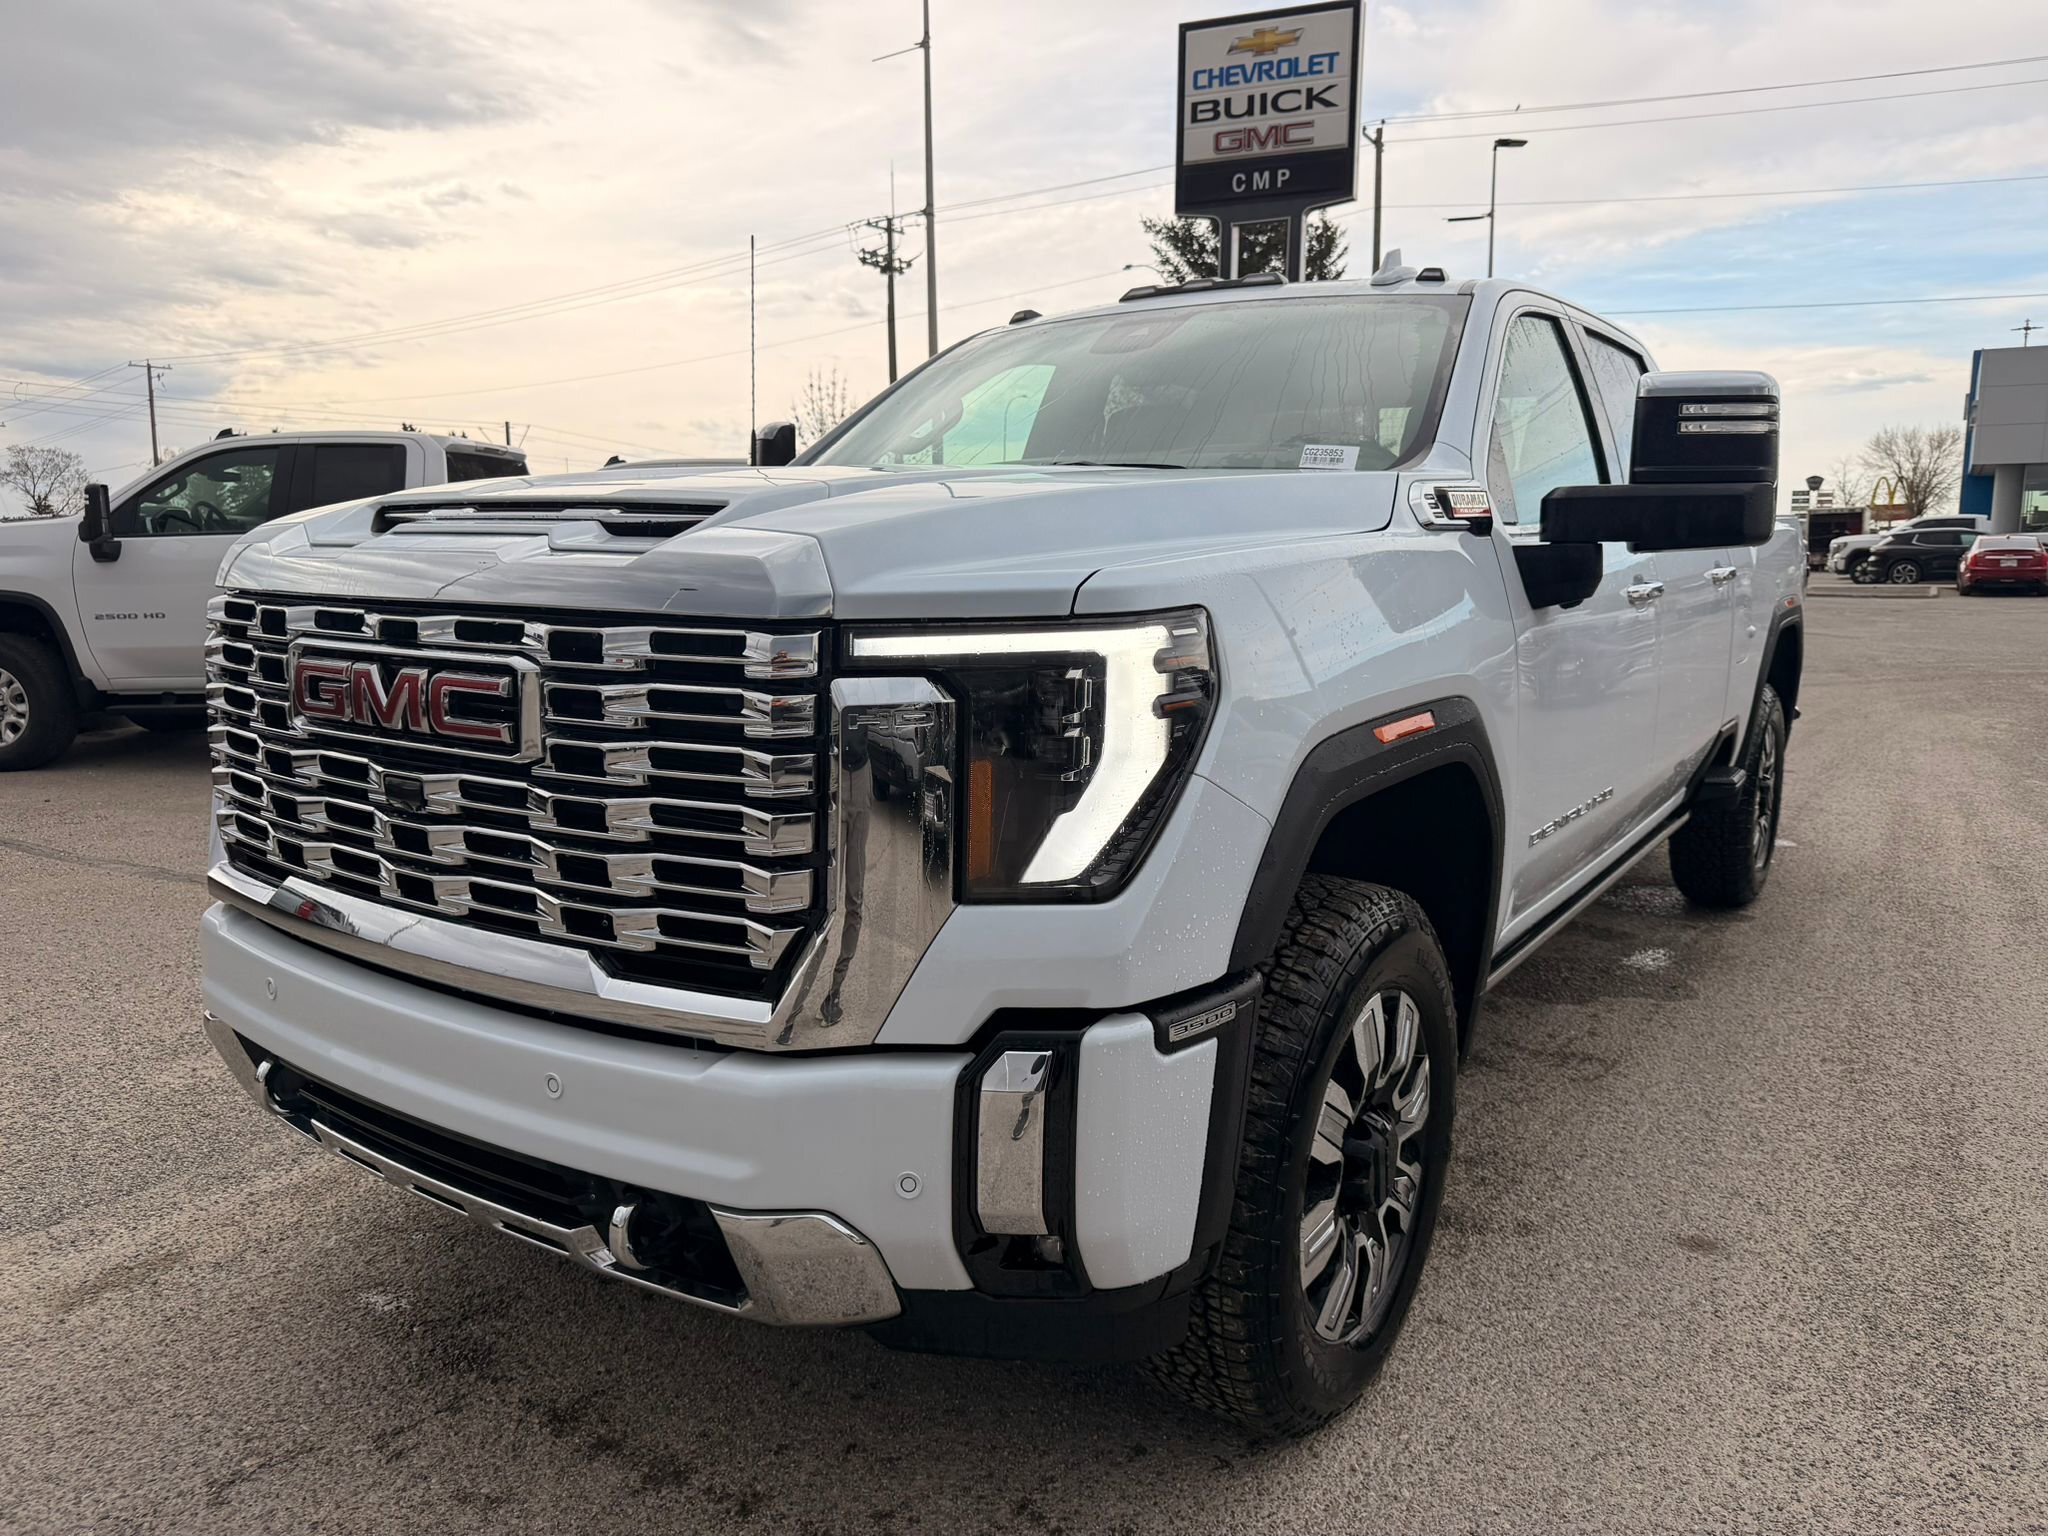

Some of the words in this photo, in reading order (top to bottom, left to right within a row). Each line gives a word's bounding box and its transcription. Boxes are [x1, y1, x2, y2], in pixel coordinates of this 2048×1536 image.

[1193, 51, 1340, 91] CHEVROLET
[1190, 84, 1339, 124] BUICK
[1213, 120, 1315, 154] GMC
[1304, 447, 1344, 457] CG235853
[1451, 493, 1487, 506] DURAMAX
[95, 612, 138, 620] 2500
[143, 611, 166, 619] HD
[294, 655, 515, 744] GMC
[1173, 1007, 1233, 1037] 3500
